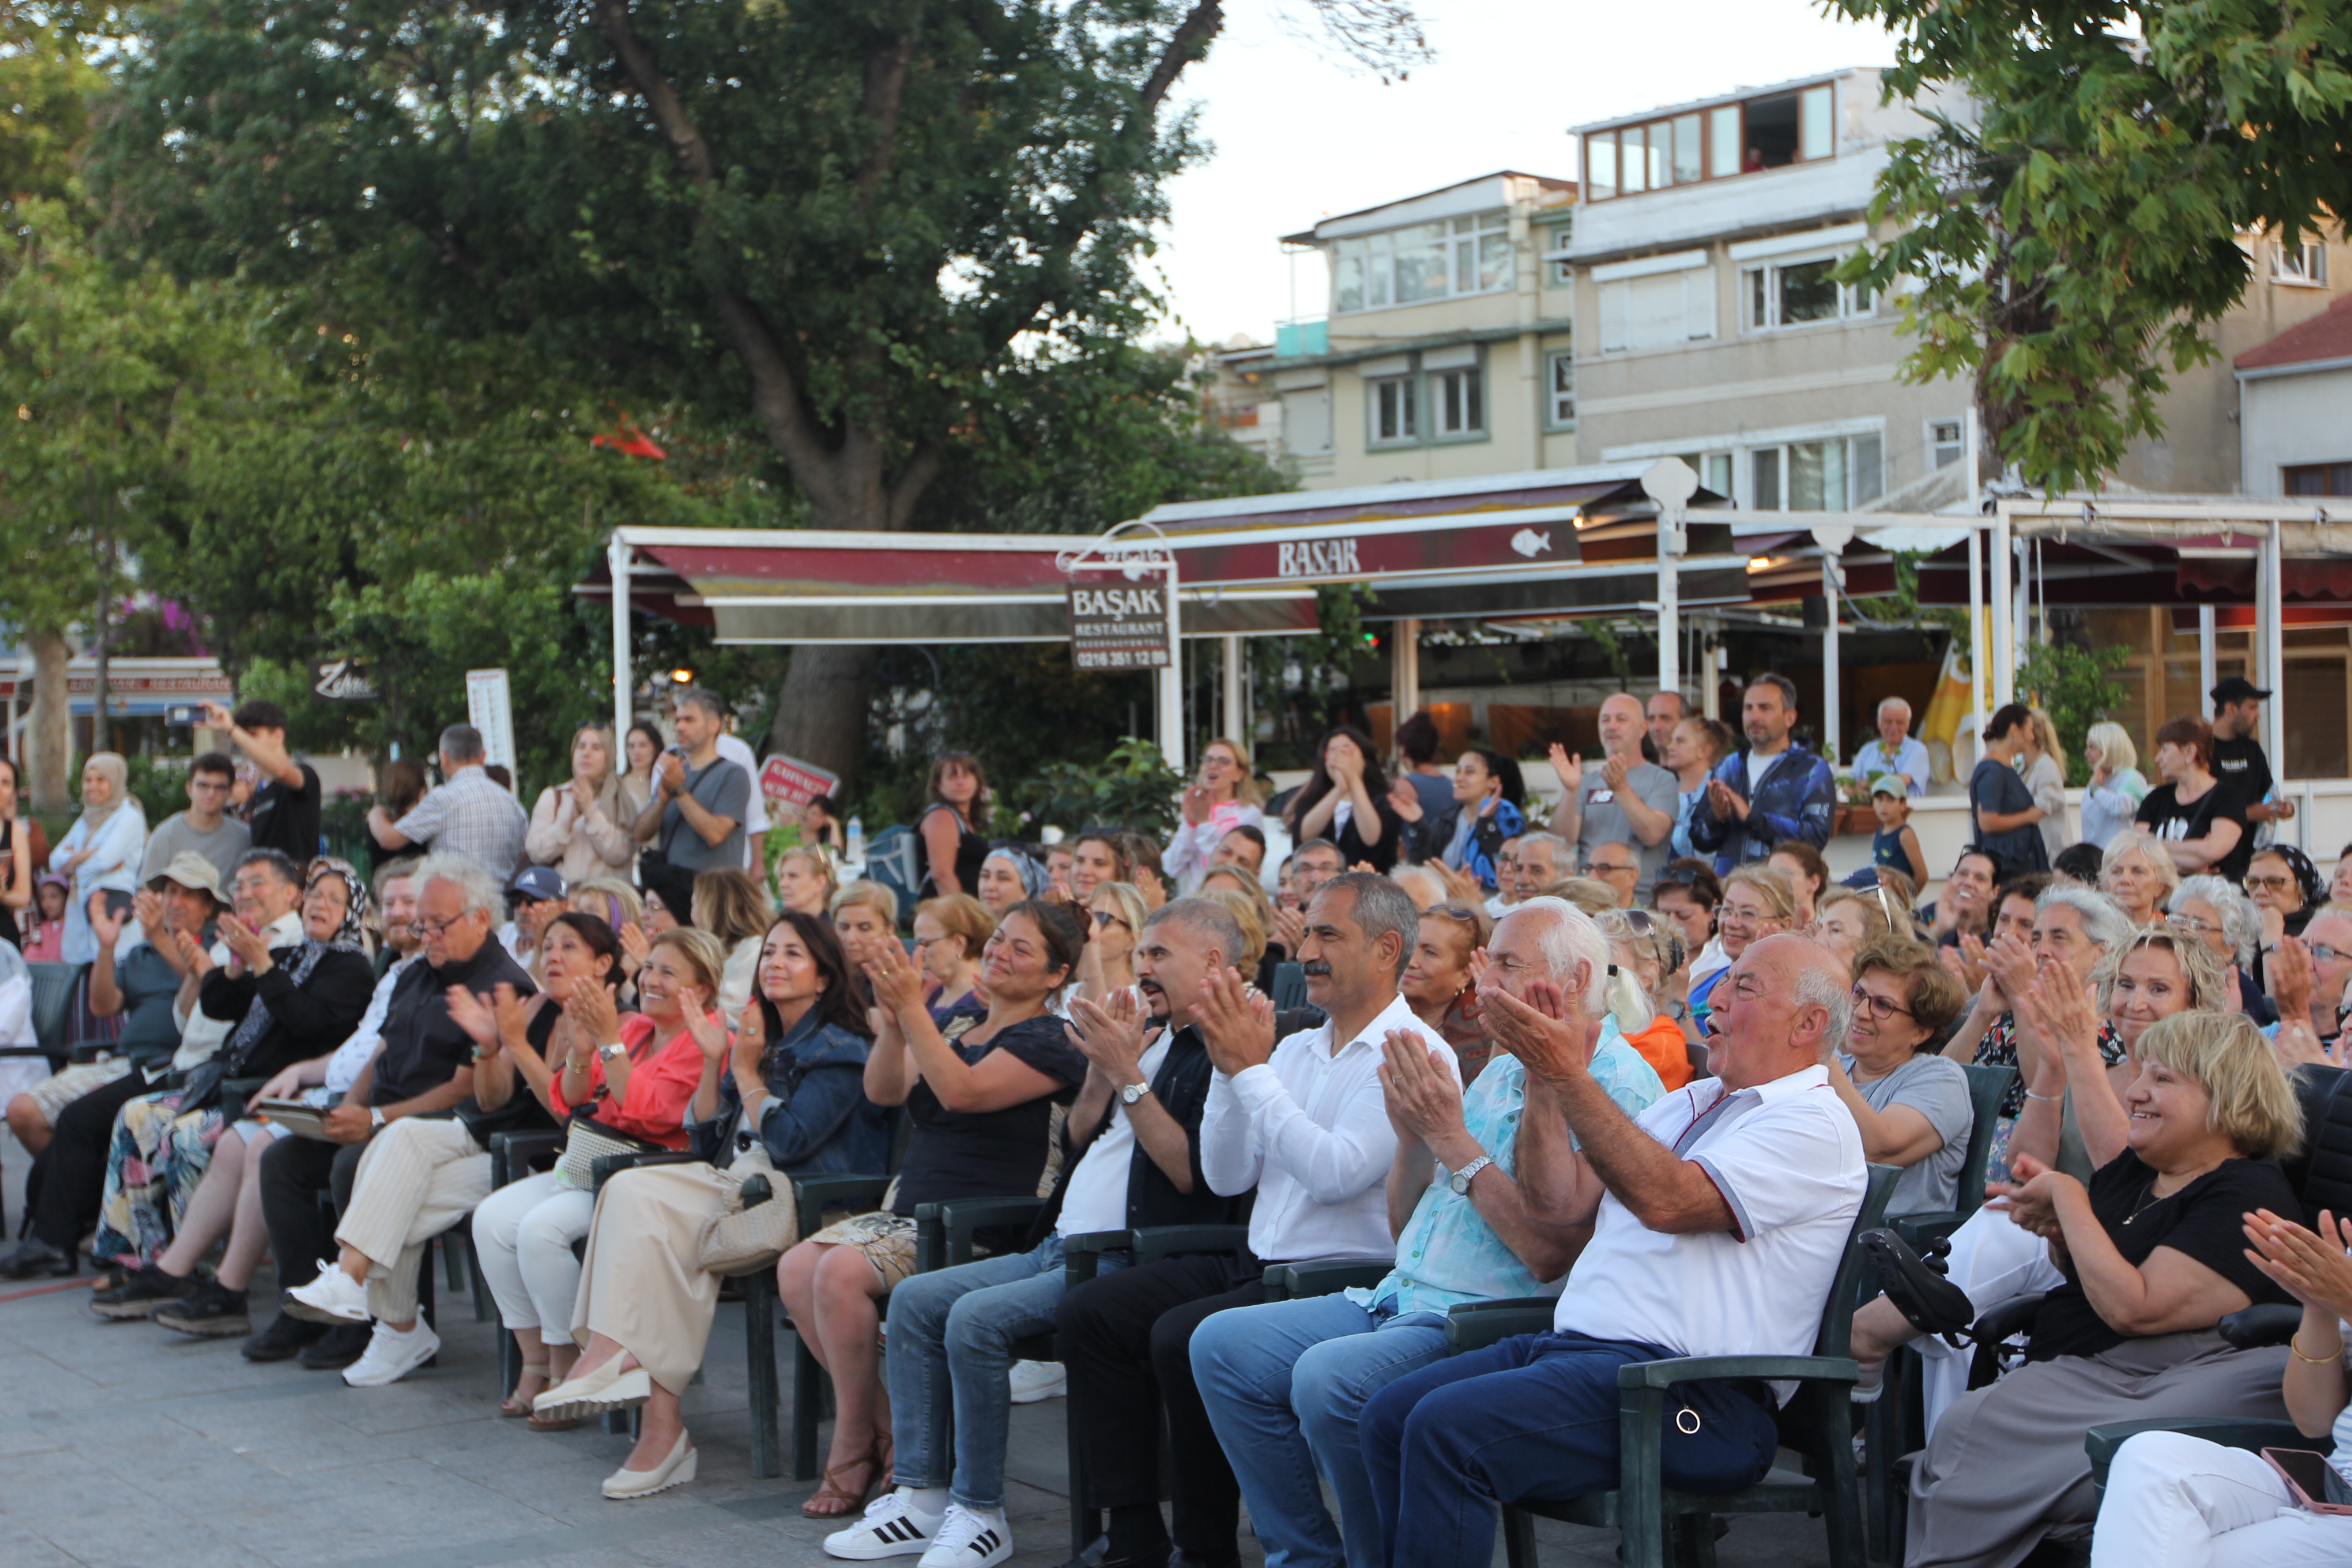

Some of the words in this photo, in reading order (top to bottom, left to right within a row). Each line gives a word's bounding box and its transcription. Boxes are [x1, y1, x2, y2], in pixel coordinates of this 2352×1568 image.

[1072, 589, 1162, 622] BAŞAK
[1075, 621, 1164, 636] RESTAURANT
[1077, 651, 1109, 668] 0216
[1109, 651, 1132, 666] 351
[1134, 650, 1150, 666] 12
